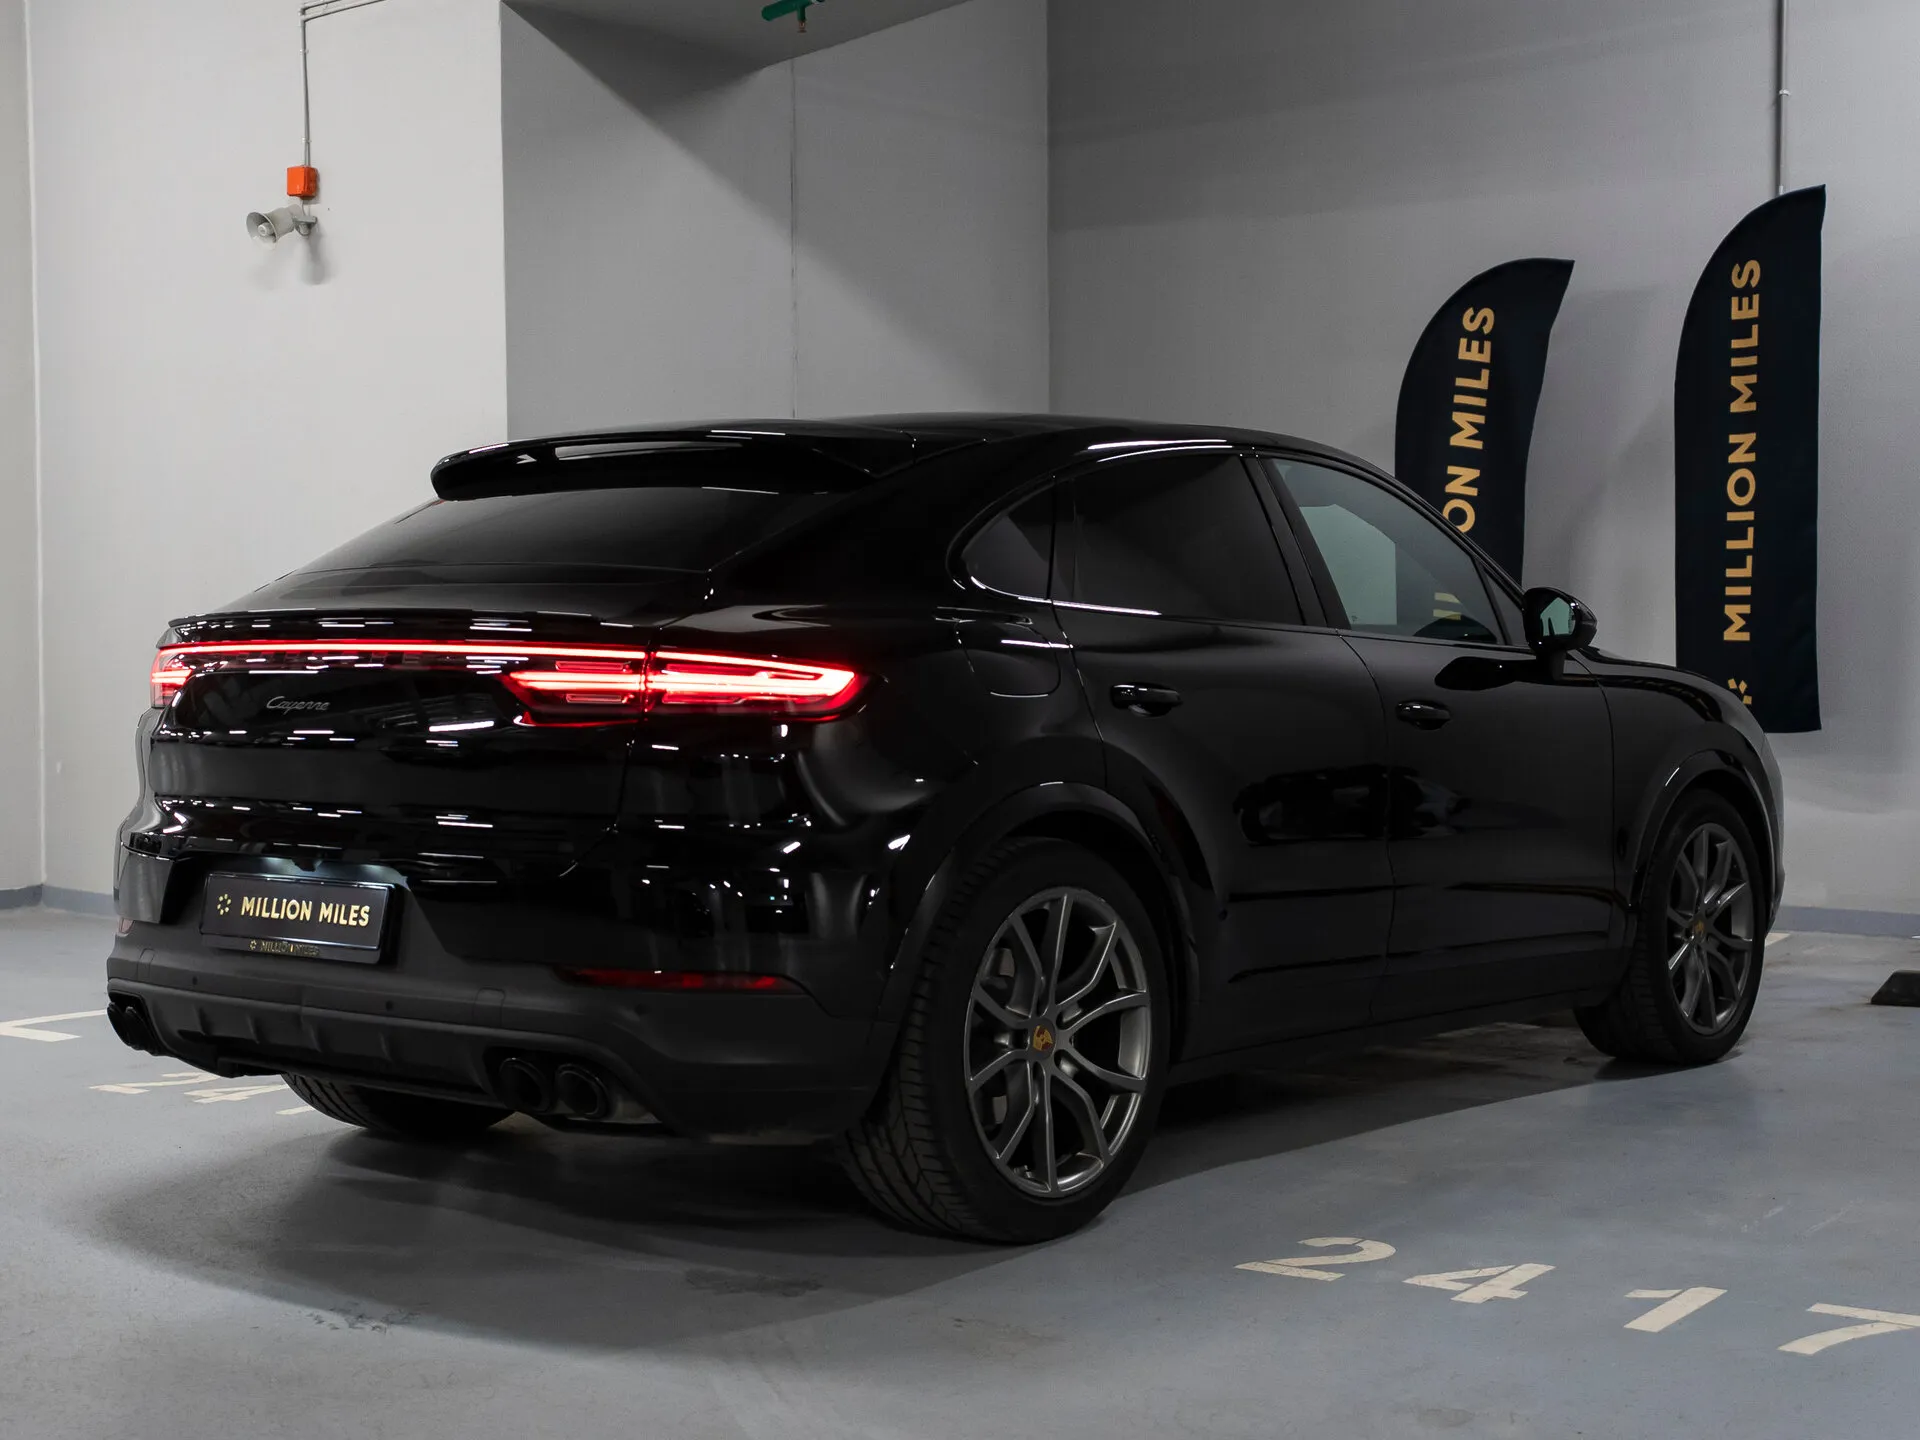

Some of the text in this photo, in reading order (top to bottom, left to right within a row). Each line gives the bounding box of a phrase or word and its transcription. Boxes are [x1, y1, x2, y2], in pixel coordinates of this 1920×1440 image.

[1449, 307, 1495, 450] MILES
[1723, 259, 1761, 642] MILLION MILES
[266, 695, 330, 715] Cayenne
[241, 896, 370, 927] MILLION MILES
